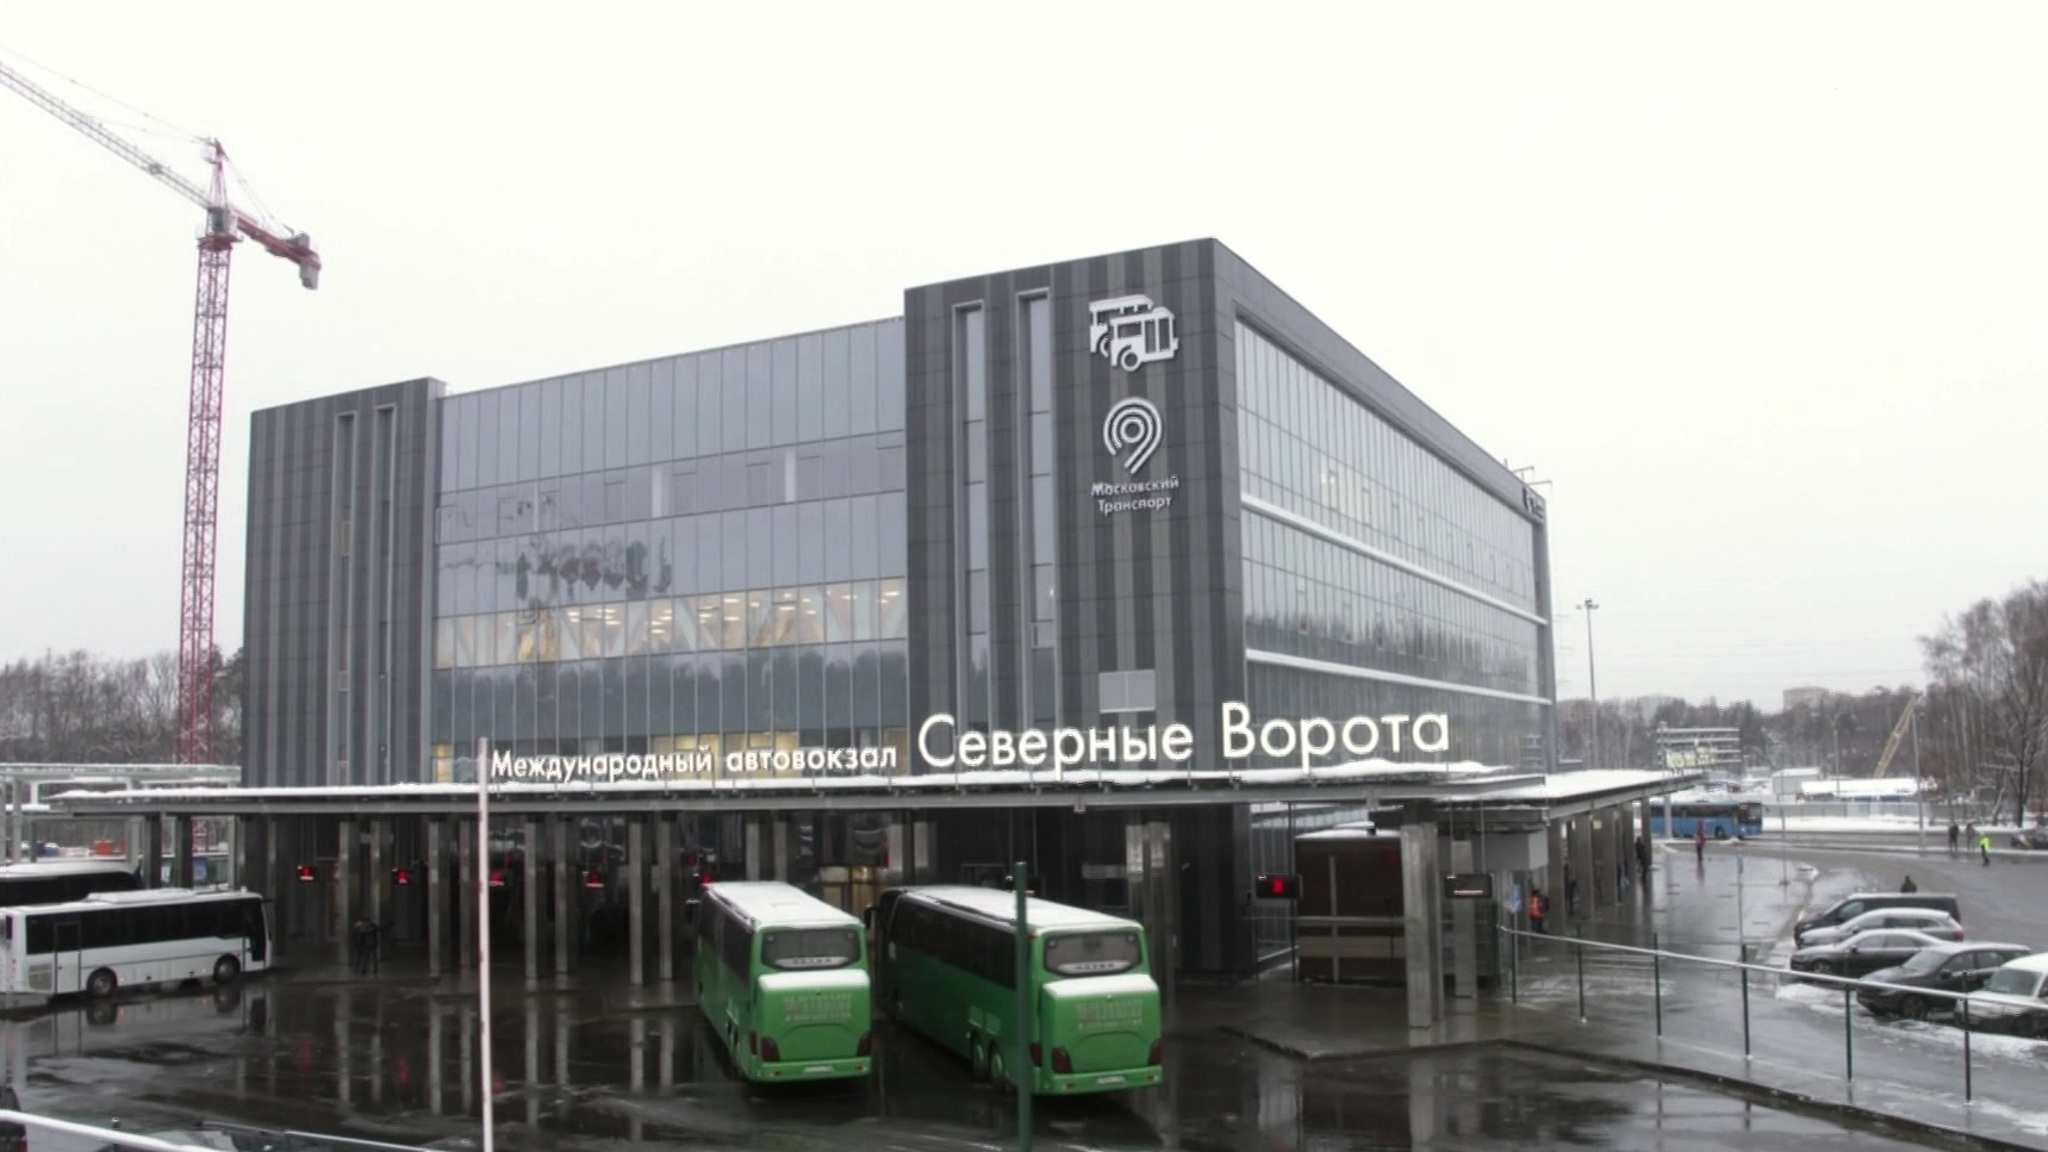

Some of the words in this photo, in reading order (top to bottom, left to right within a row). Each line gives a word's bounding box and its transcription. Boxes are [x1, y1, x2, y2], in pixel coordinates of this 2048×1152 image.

[1091, 475, 1179, 497] Московский
[1098, 497, 1172, 516] Транспорт
[918, 714, 1193, 781] Северные
[1222, 701, 1449, 773] Ворота
[491, 745, 713, 783] Международный
[726, 746, 897, 771] автовокзал
